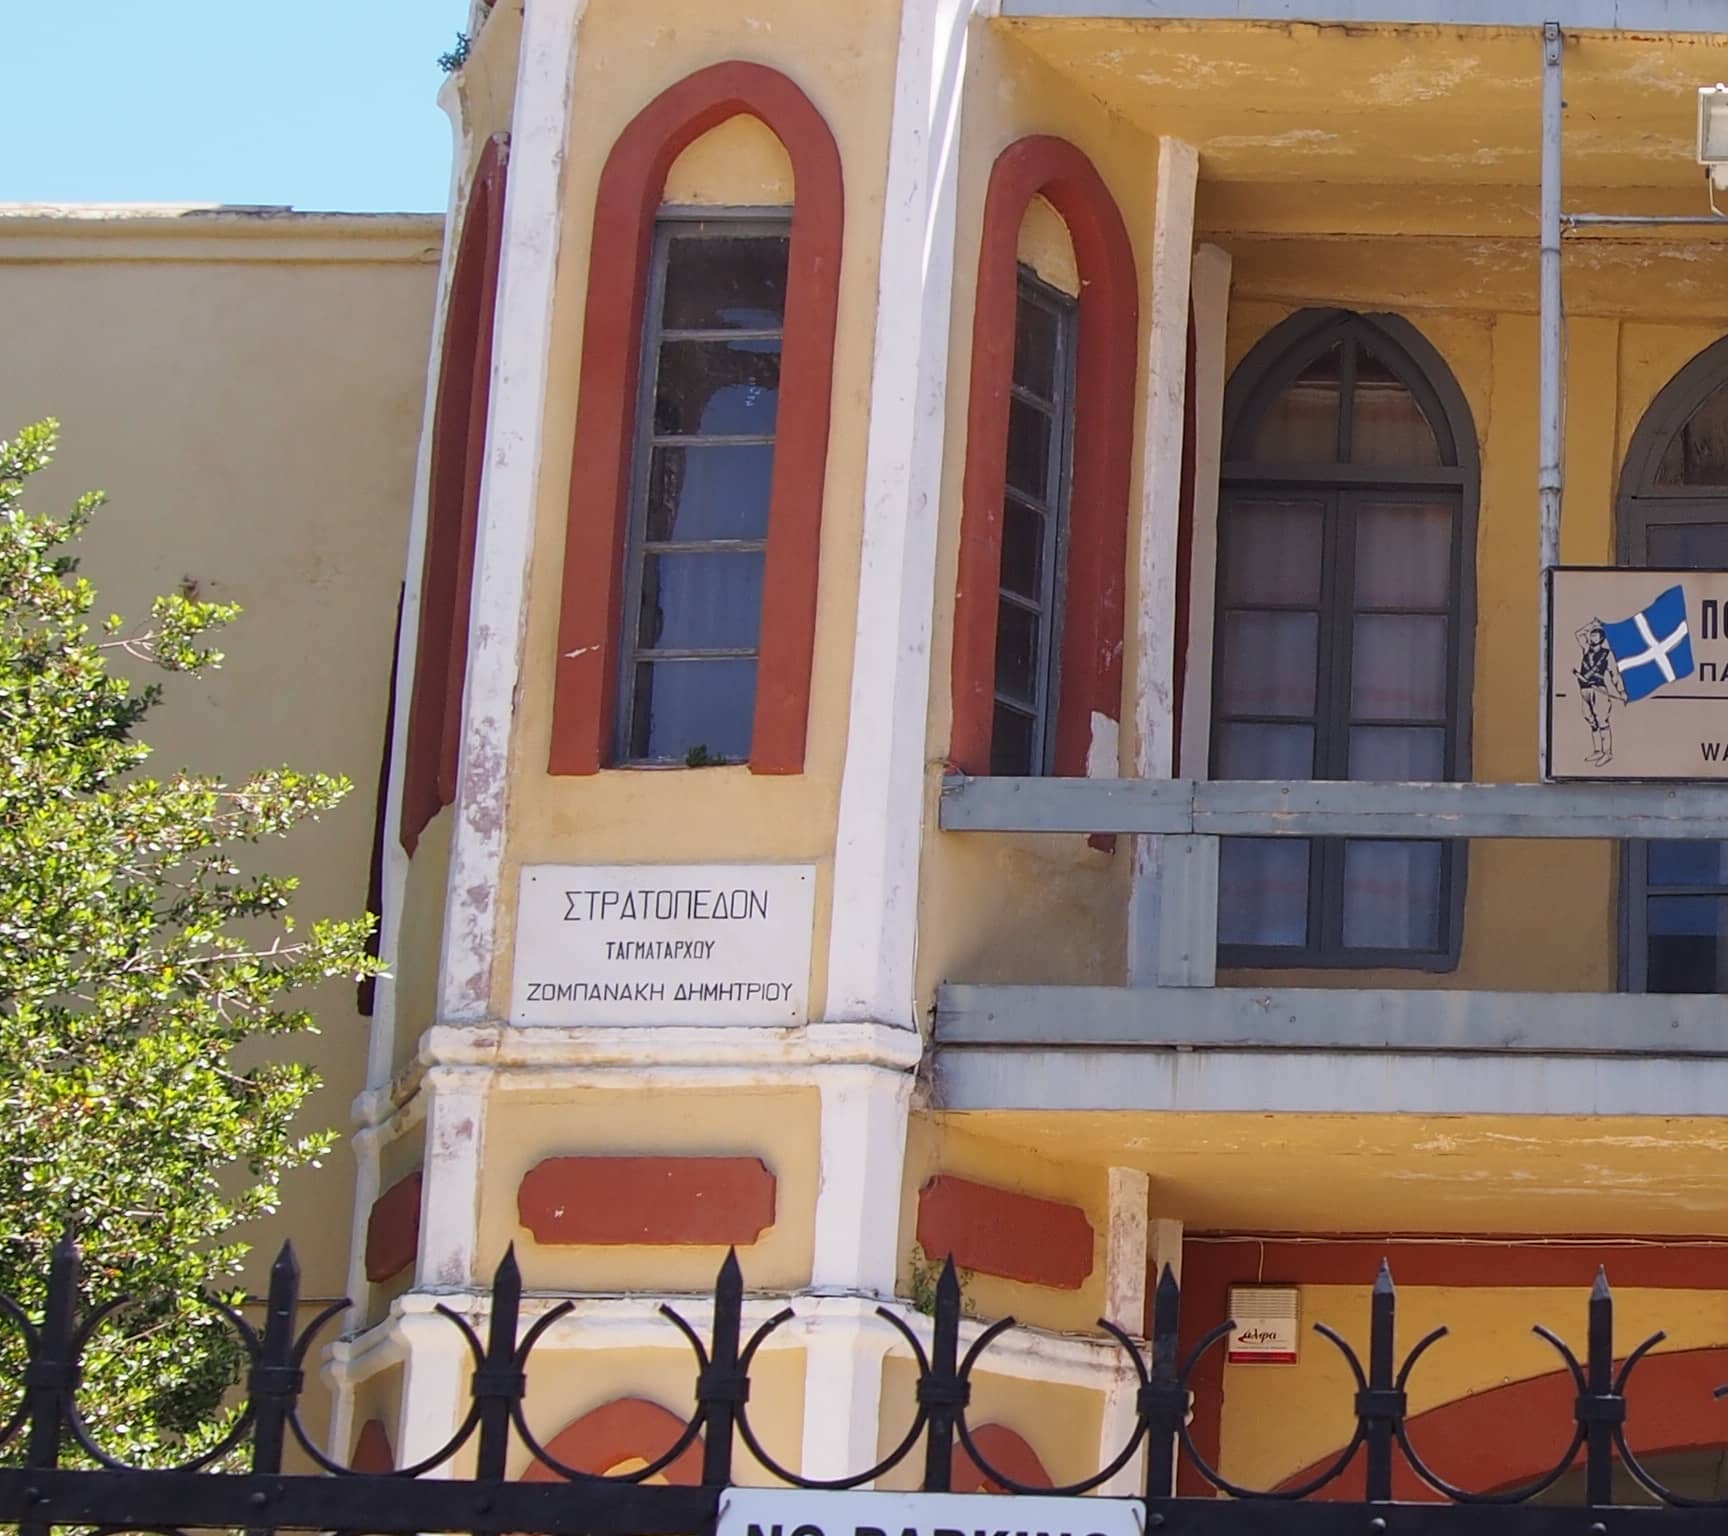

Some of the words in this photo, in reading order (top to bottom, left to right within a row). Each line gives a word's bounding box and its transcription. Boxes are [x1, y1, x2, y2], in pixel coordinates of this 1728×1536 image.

[563, 889, 768, 921] ΣΤΡΑΤΟΠΕΔΟΝ
[606, 940, 716, 961] ΤΑΓΜΑΤΑΡΧΟΥ
[526, 982, 664, 1002] ΖΟΜΠΑΝΑΚΗ
[673, 982, 793, 1002] ΔΗΜΗΤΡΙΟΥ
